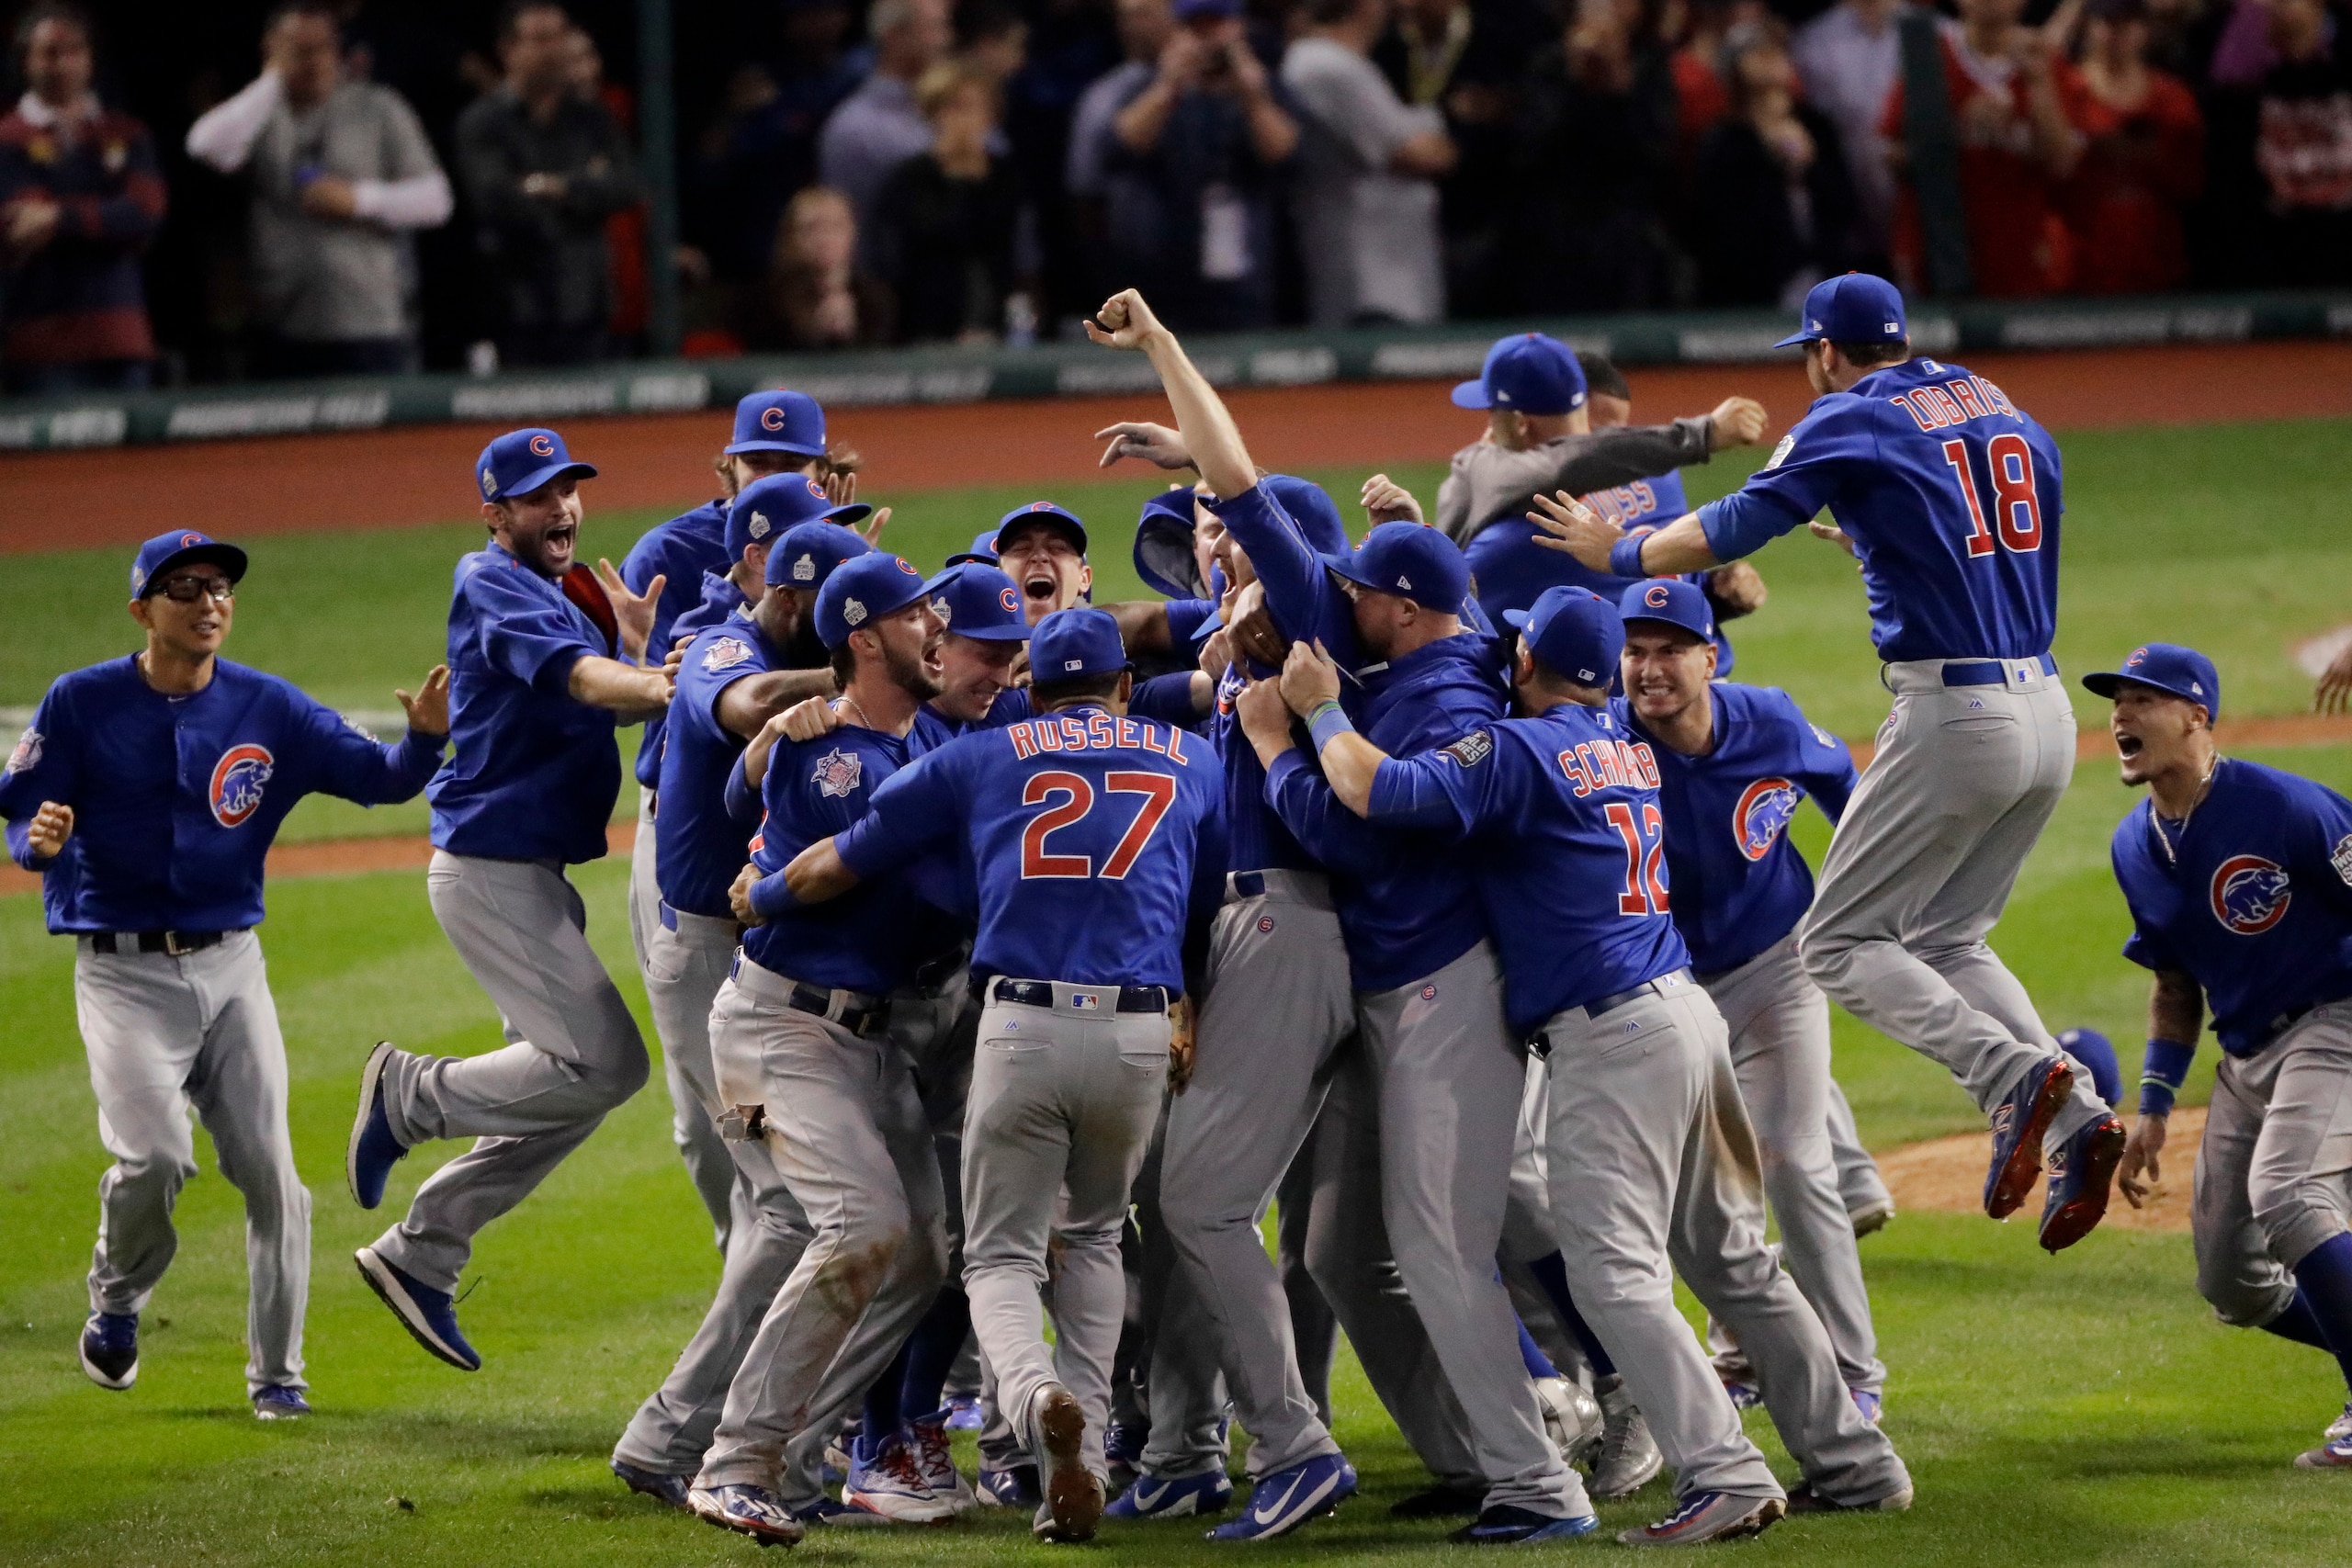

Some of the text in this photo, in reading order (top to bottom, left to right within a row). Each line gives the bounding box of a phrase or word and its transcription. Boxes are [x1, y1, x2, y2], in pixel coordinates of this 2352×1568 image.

[761, 407, 786, 431] C
[529, 435, 554, 457] C
[1941, 433, 2043, 558] 18
[895, 557, 918, 576] C
[999, 587, 1019, 613] C
[1645, 586, 1669, 608] C
[2127, 647, 2149, 667] C
[1007, 714, 1190, 766] RUSSELL
[1021, 770, 1177, 880] 27
[1603, 802, 1670, 917] 12
